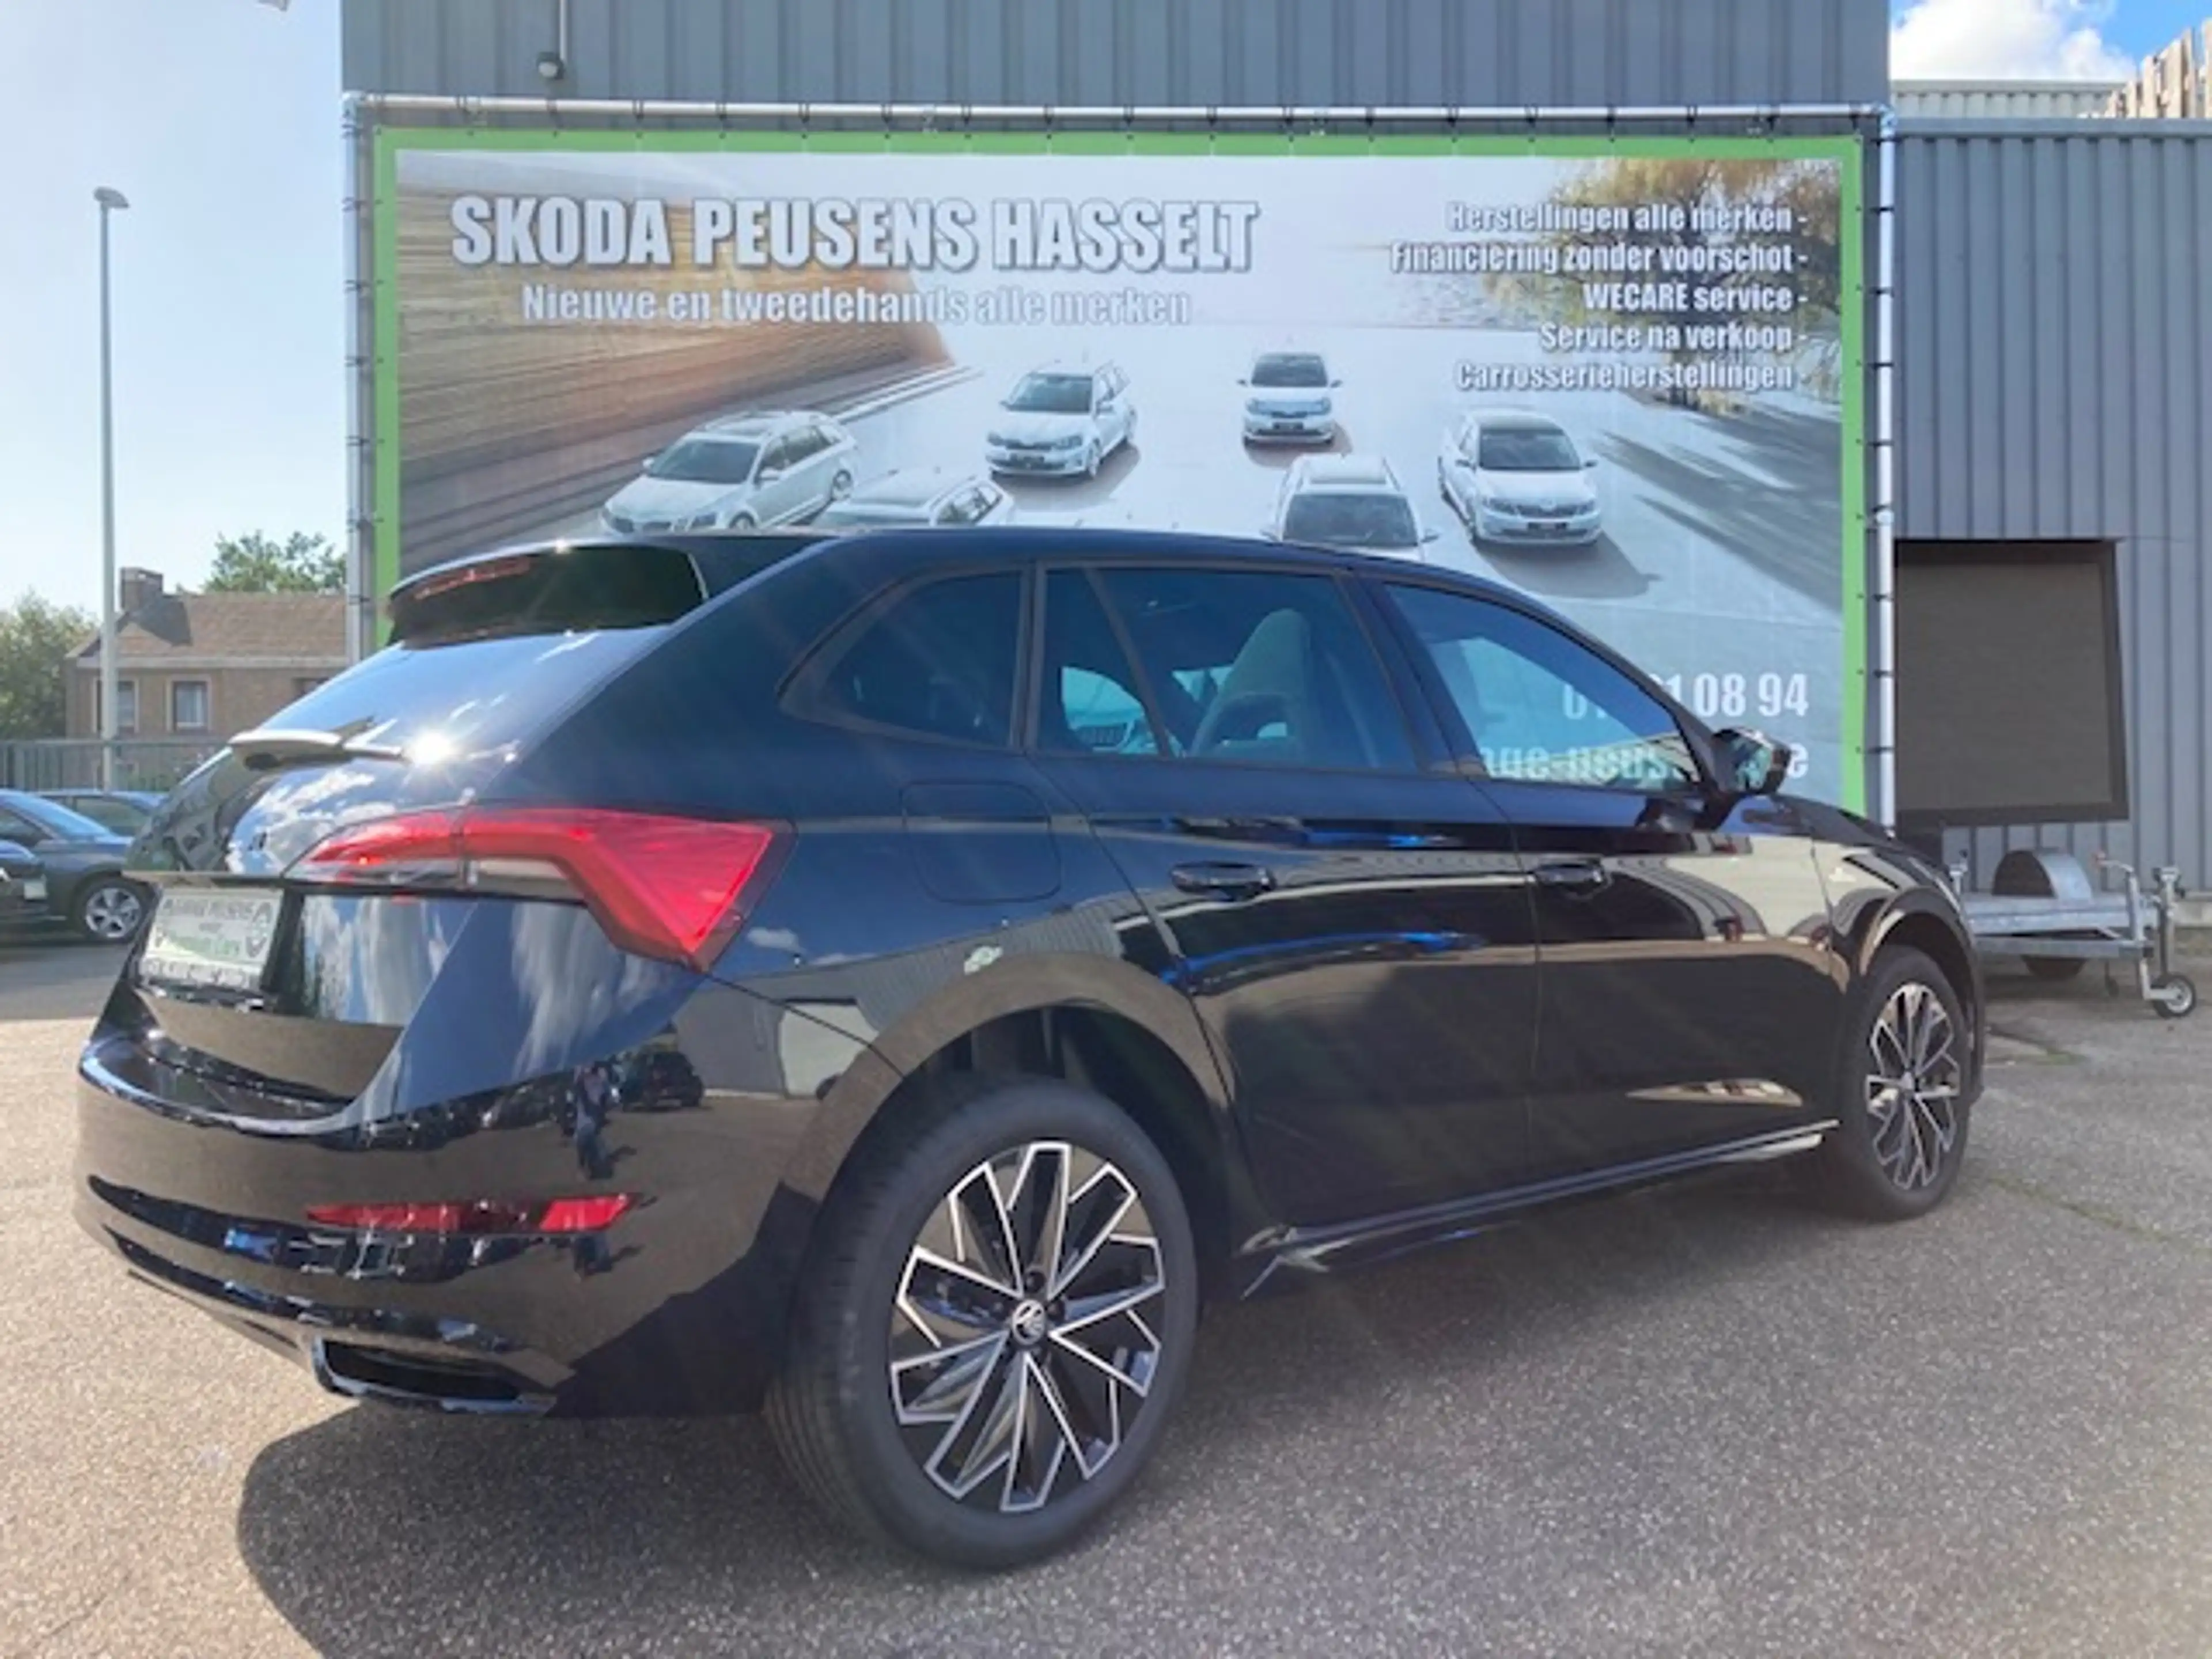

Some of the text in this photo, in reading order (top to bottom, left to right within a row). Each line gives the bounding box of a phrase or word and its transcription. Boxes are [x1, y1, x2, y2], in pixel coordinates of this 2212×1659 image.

[1448, 203, 1629, 232] Herstellingen
[1634, 203, 1685, 231] alle
[1690, 202, 1792, 232] merken
[451, 196, 1260, 273] SKODA PEUSENS HASSELT
[1391, 241, 1558, 275] Financiering
[1563, 242, 1652, 272] zonder
[1659, 242, 1793, 272] voorschot
[522, 285, 1190, 325] Nieuwe en tweedehands alle merken
[1583, 282, 1690, 311] WECARE
[1693, 283, 1793, 312] service
[1540, 321, 1641, 350] Service
[1648, 325, 1681, 350] na
[1684, 320, 1793, 353] verkoop
[1456, 361, 1793, 392] Carrosserieherstellingen
[1692, 672, 1747, 718] 08
[1758, 672, 1809, 718] 94
